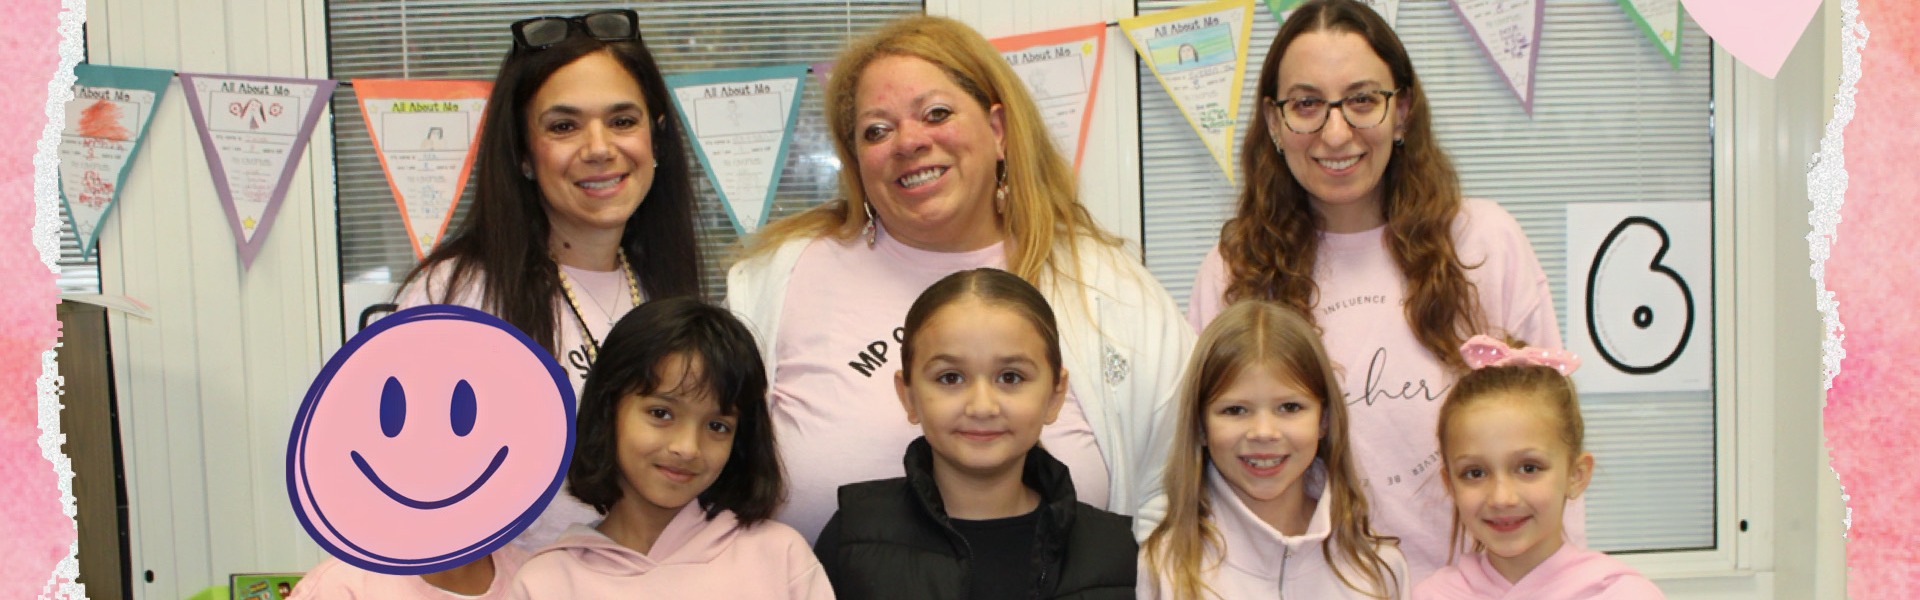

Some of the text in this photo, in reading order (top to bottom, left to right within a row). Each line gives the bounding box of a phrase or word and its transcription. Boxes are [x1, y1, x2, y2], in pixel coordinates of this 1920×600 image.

[1154, 16, 1219, 38] All About Me
[1022, 48, 1051, 64] About
[1055, 46, 1071, 59] Me
[80, 86, 110, 100] About
[115, 90, 130, 102] Me
[221, 82, 290, 97] All About Me
[704, 83, 771, 99] All About Me
[392, 101, 459, 113] All About Me
[1586, 216, 1695, 375] 6
[1323, 294, 1386, 316] INFLUENCE
[848, 340, 888, 378] MP
[1387, 475, 1401, 486] BE
